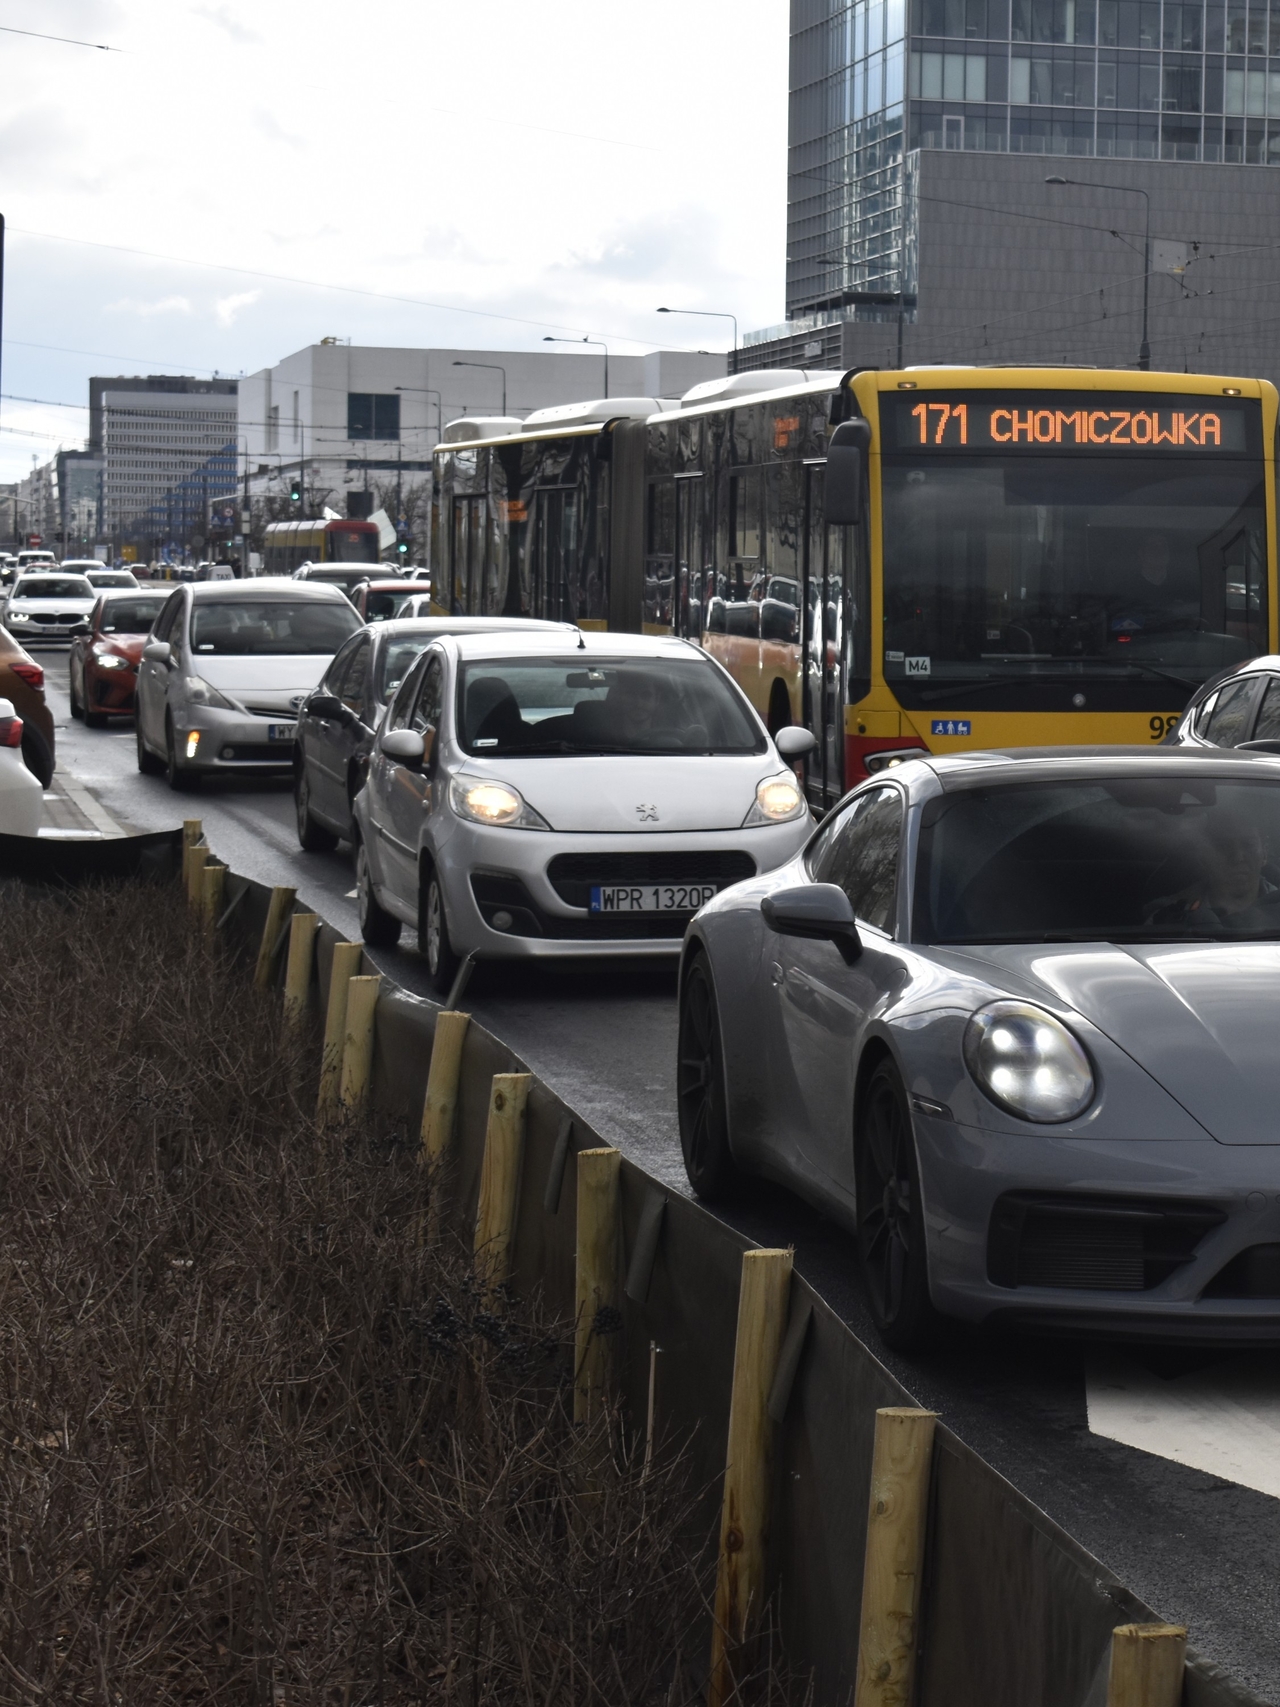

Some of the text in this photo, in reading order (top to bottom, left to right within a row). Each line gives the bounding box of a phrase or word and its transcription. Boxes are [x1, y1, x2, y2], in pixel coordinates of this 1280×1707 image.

[912, 403, 1221, 445] 171 CHOMICZÓWKA
[908, 659, 928, 672] M4
[602, 888, 643, 910] WPR
